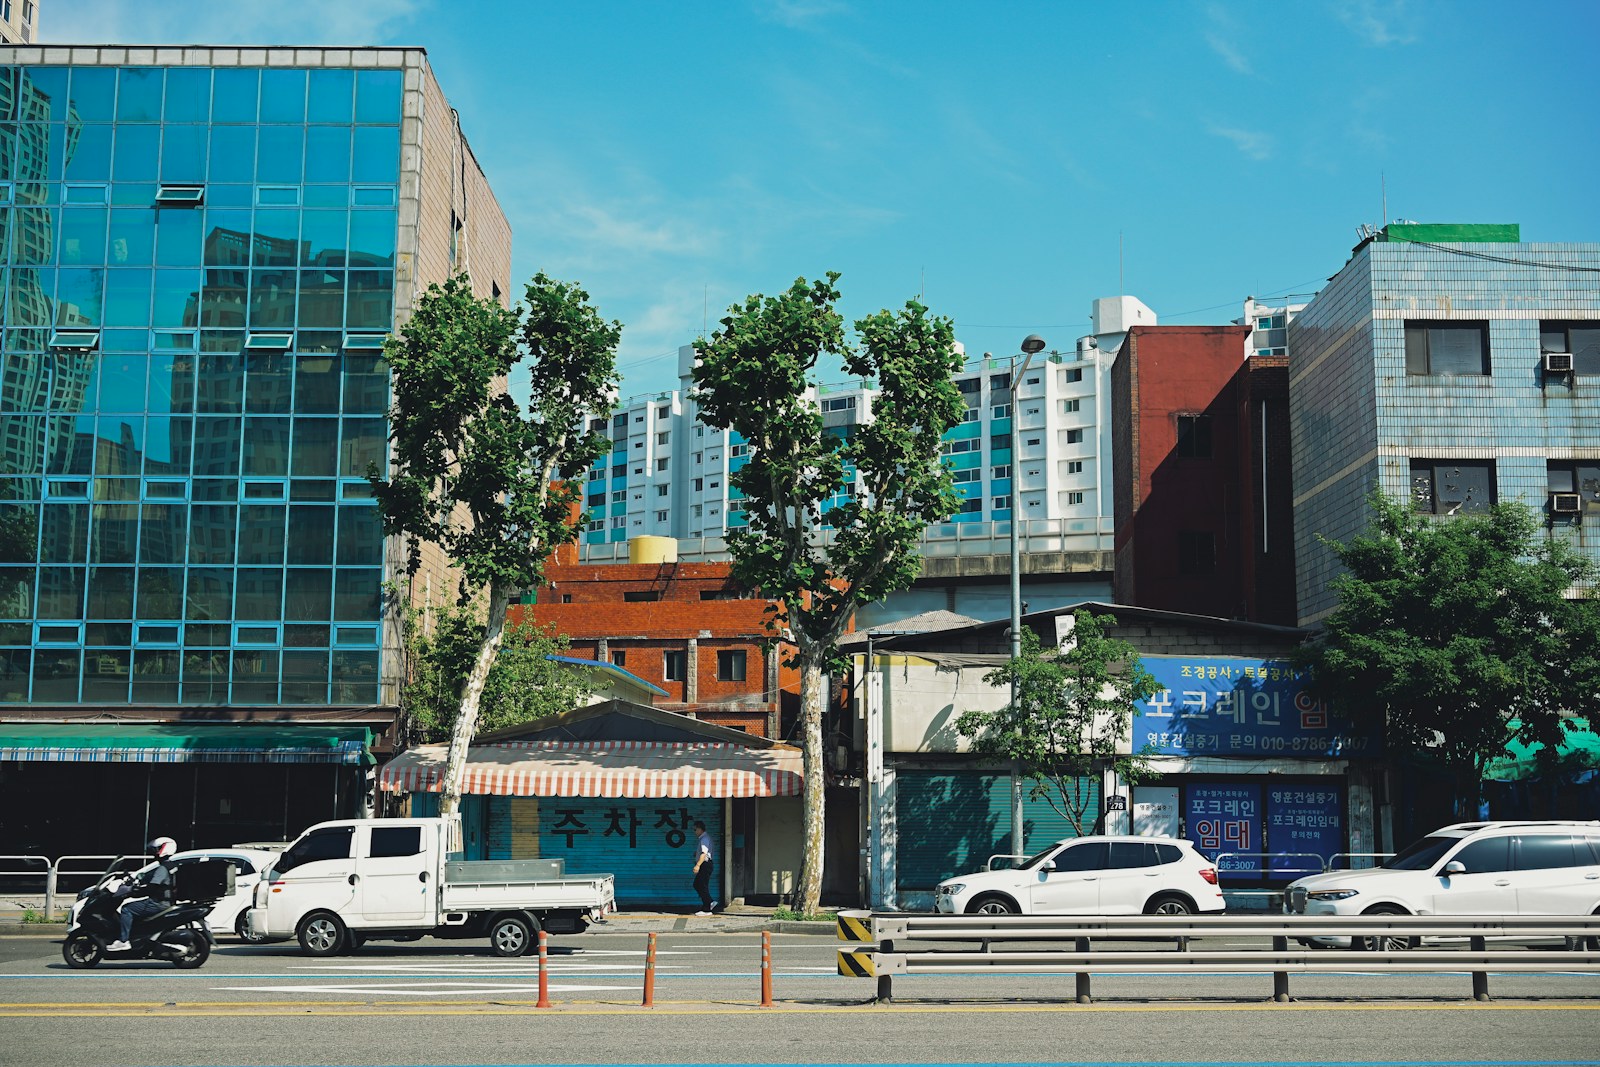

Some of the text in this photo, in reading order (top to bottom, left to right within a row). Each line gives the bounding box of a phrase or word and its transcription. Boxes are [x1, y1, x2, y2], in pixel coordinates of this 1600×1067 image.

[1145, 688, 1281, 725] 포크레인
[1229, 733, 1256, 749] 문의
[1271, 791, 1337, 804] 영훈건설중기
[1191, 800, 1255, 817] 포크레인
[551, 807, 694, 849] 주차장
[1273, 814, 1339, 828] 포크레인임대
[1195, 819, 1250, 850] 임대
